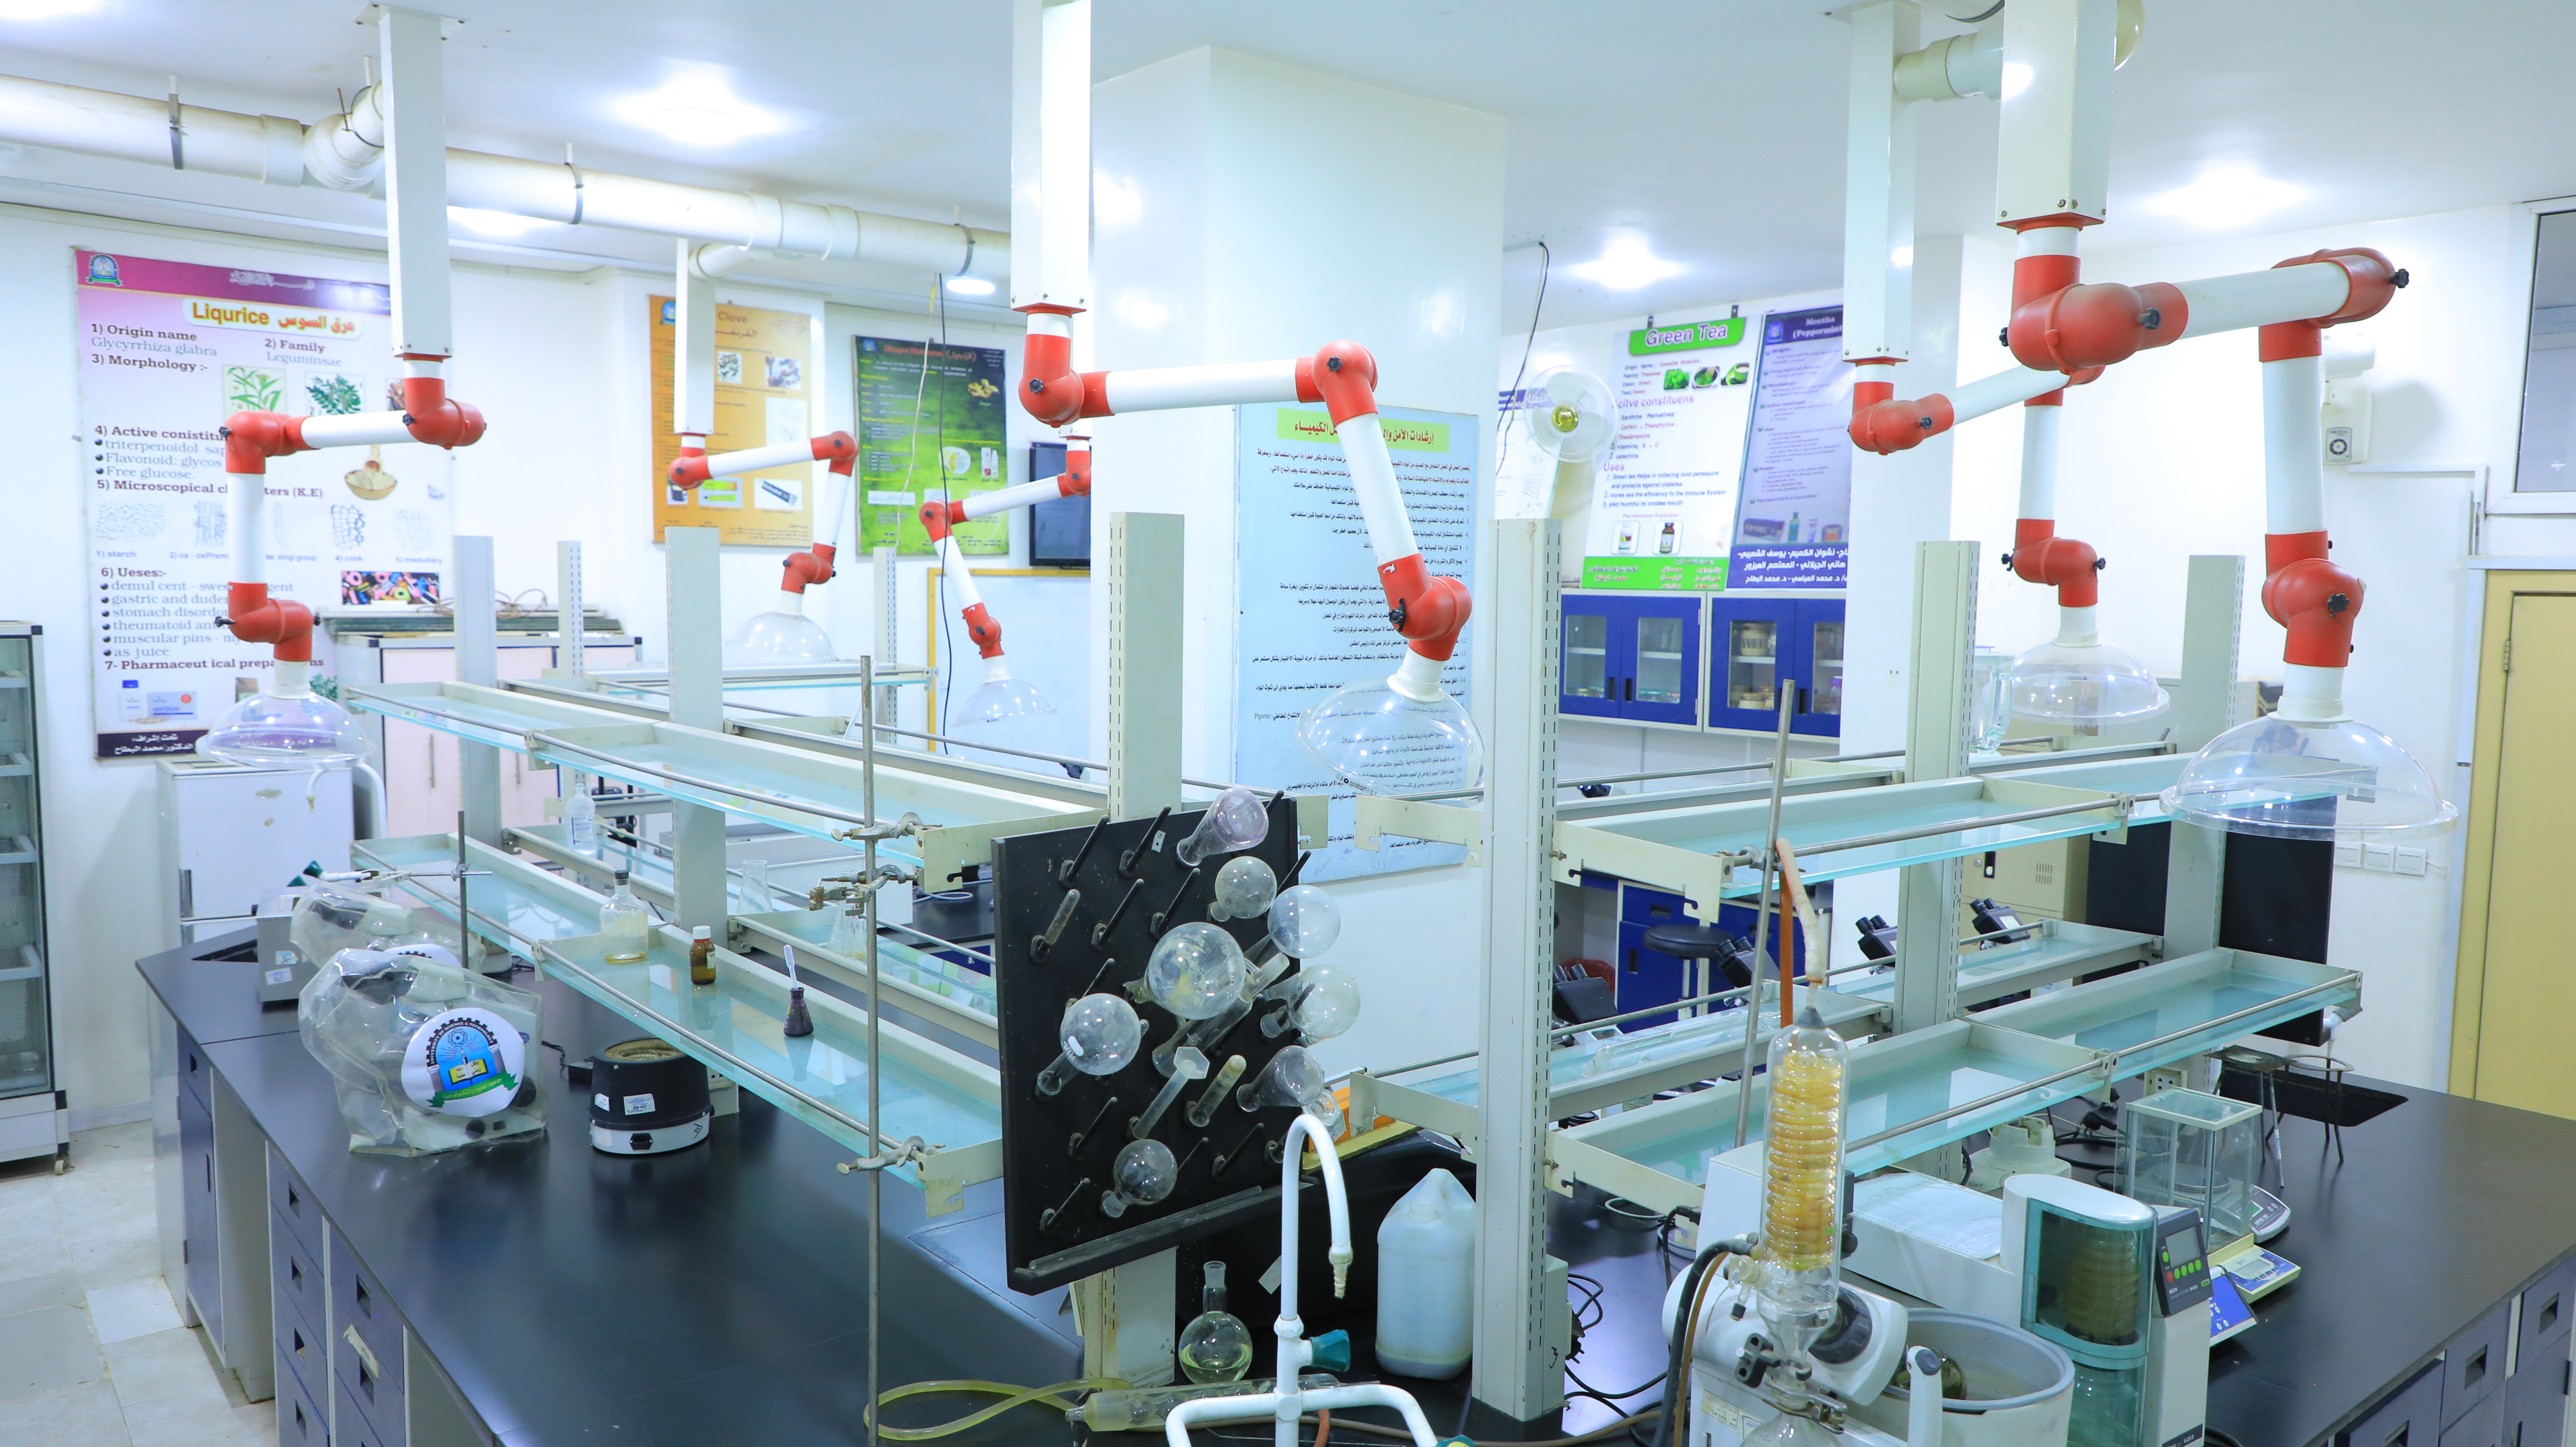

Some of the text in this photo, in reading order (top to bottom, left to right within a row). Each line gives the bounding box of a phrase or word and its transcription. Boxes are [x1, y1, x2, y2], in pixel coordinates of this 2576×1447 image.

[192, 302, 270, 325] Liqurice
[718, 311, 747, 323] Clove
[279, 316, 354, 334] عرق السوس
[1806, 316, 1835, 326] Mentha
[91, 323, 197, 341] 1) Origin name
[1647, 324, 1727, 346] Green Tea
[91, 337, 217, 356] Glycyrrhiza glabra
[264, 339, 325, 354] 2) Family
[92, 354, 196, 372] 3) Morphology
[268, 352, 342, 366] Leguminsae
[1641, 395, 1694, 407] constituens
[95, 425, 107, 436] 4)
[112, 427, 158, 437] Active
[1393, 428, 1409, 442] الأمن
[1410, 430, 1434, 445] إرشادات
[106, 441, 197, 453] triterpenoidol
[106, 453, 222, 468] Flavonoid: glycos
[1314, 454, 1322, 462] يكون
[1604, 462, 1625, 471] Uses
[107, 466, 195, 480] Free glucose.
[97, 480, 323, 498] 5) Microscopical (K.E)
[1766, 549, 1787, 559] يوسف
[1814, 547, 1835, 558] نشوان
[1766, 560, 1795, 571] المعتصم
[1801, 560, 1827, 571] الجيلاني
[1827, 561, 1846, 570] هاني
[102, 568, 113, 578] 6)
[1792, 574, 1815, 584] العباسي
[1745, 575, 1763, 584] البطاح
[112, 581, 187, 591] demul cent
[112, 594, 187, 607] gastric and
[112, 607, 171, 617] stomach
[113, 621, 191, 630] theumatoid
[114, 633, 211, 645] muscular pins
[114, 647, 169, 659] as juice
[105, 659, 235, 669] 7- Pharmaceut ical
[115, 745, 141, 755] البطاح
[1349, 780, 1367, 790] alsident
[430, 1035, 441, 1064] UNIVERSITY
[439, 1029, 445, 1037] OF
[444, 1021, 464, 1031] SCIENCE
[469, 1022, 494, 1044] TECHNOLOGY
[488, 1078, 502, 1088] جامعة
